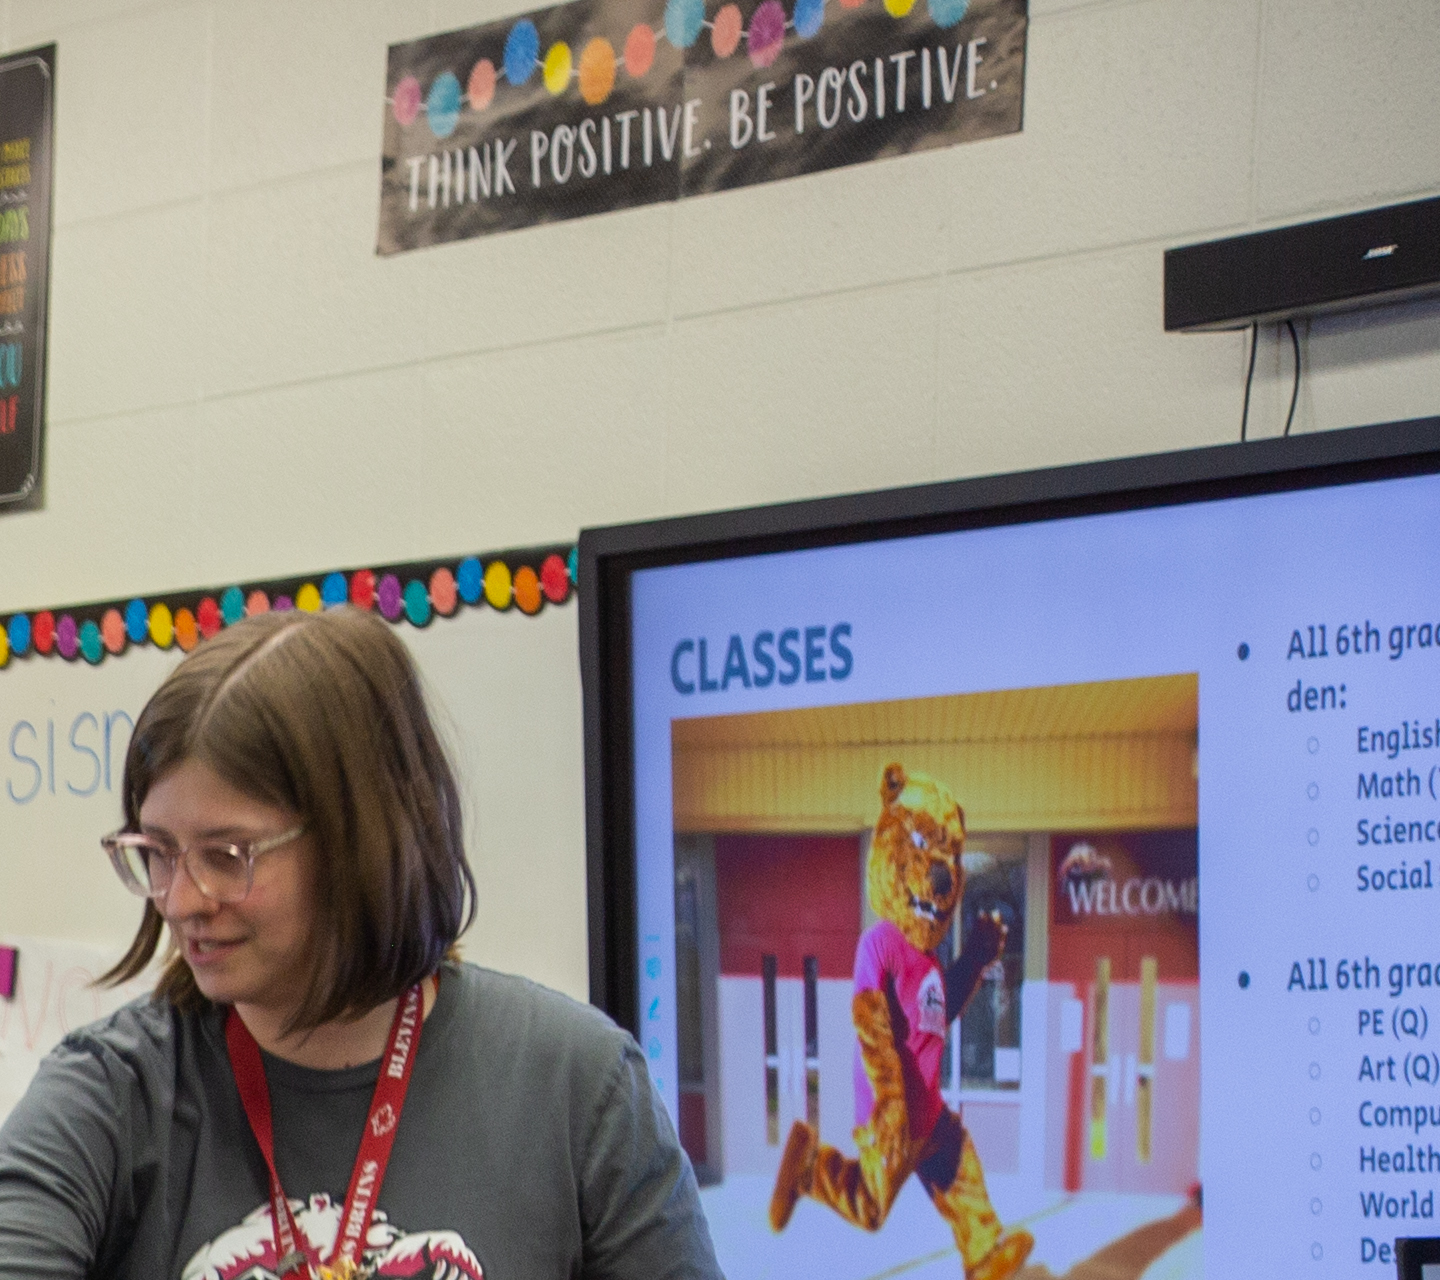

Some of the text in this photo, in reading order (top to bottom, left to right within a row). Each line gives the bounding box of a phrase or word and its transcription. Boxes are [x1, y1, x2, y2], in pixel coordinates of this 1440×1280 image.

[406, 37, 999, 212] THINK POSITIVE. BE POSITIVE.
[1287, 625, 1329, 660] All
[1336, 620, 1380, 656] 6th
[670, 623, 853, 695] CLASSES
[1287, 679, 1346, 712] den:
[1357, 767, 1421, 800] Math
[1357, 815, 1440, 846] Scienc
[1357, 860, 1432, 892] Social
[1287, 958, 1328, 991] All
[1336, 957, 1380, 990] 6th
[1358, 1006, 1428, 1041] PE (Q)
[1359, 1052, 1440, 1086] Art (Q)
[1359, 1145, 1440, 1173] Health
[1360, 1191, 1434, 1219] World
